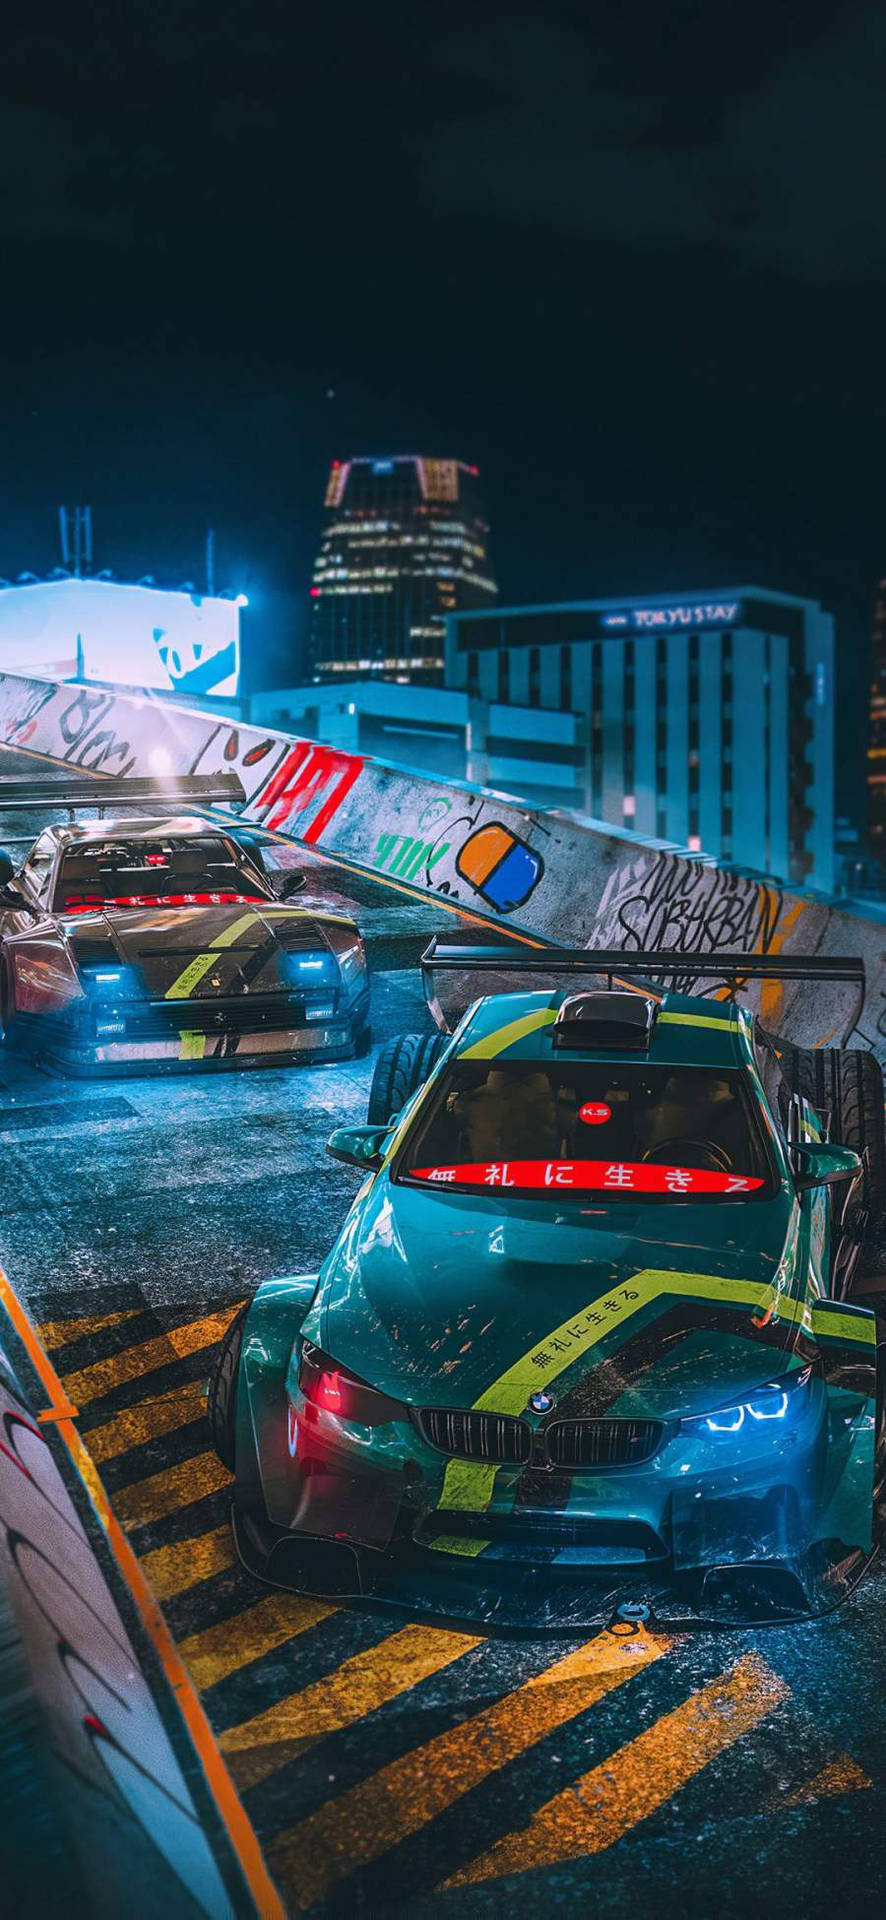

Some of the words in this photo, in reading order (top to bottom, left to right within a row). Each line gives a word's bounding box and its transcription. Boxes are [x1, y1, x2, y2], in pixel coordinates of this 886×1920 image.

[635, 608, 691, 626] TOKYU
[695, 604, 737, 622] STAY
[531, 1289, 639, 1369] 無礼に生きる
